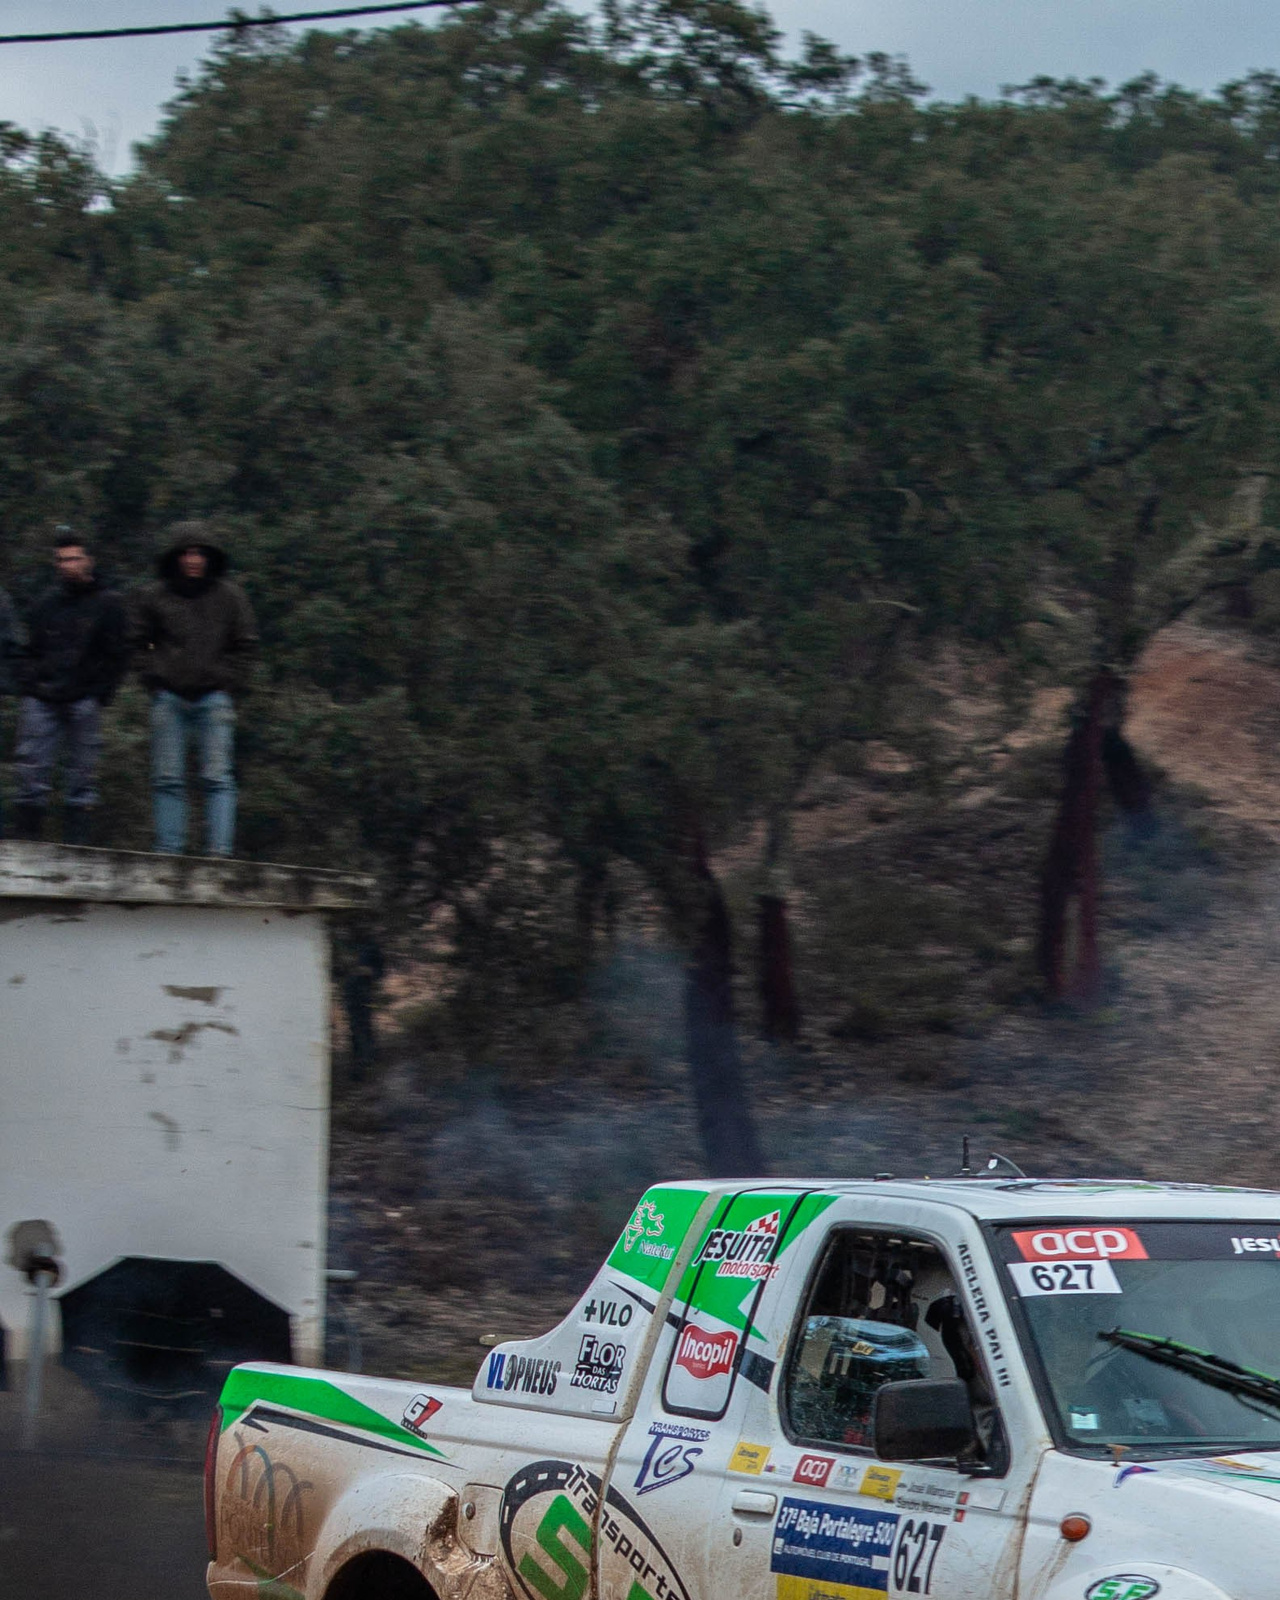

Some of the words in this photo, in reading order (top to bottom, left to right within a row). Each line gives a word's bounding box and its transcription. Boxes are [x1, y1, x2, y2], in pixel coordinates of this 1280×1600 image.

[692, 1229, 777, 1266] JESUITA
[1031, 1230, 1129, 1258] acp
[716, 1260, 780, 1280] motorsport
[1031, 1263, 1094, 1292] 627
[578, 1334, 627, 1369] FLOR
[681, 1332, 732, 1371] Incopil
[570, 1372, 619, 1395] HORTAS
[592, 1365, 606, 1377] DAS
[650, 1421, 711, 1440] TRANSPORTES
[800, 1458, 828, 1482] acp
[795, 1509, 820, 1540] Baja
[818, 1513, 875, 1548] Portalegre
[895, 1519, 947, 1594] 627
